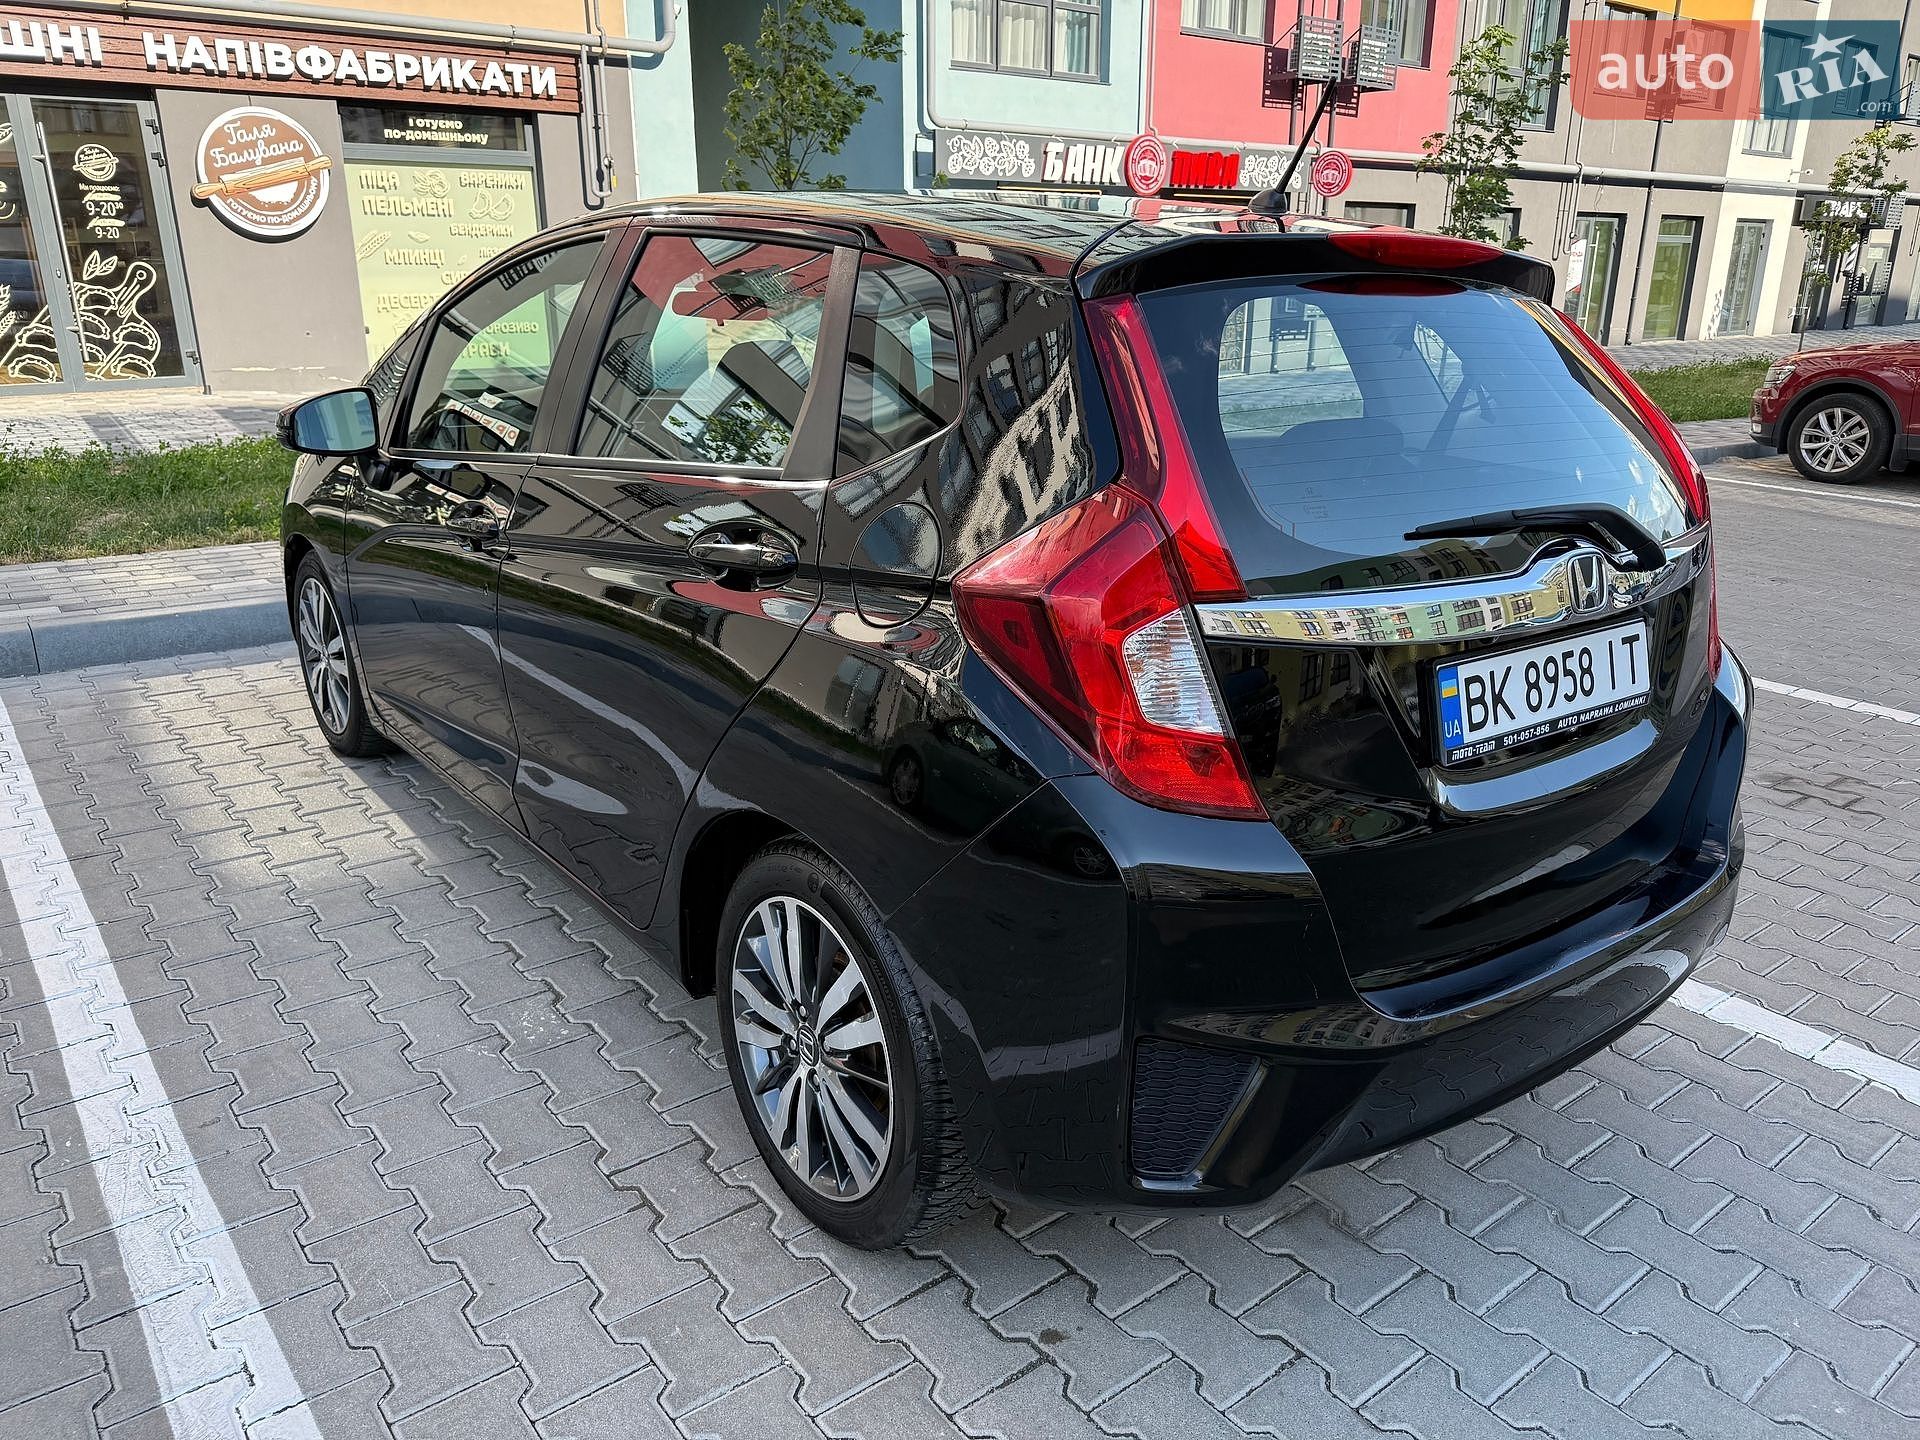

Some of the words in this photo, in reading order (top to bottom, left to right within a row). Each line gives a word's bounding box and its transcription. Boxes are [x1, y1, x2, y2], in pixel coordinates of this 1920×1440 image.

[142, 31, 558, 97] НАПІВФАБРИКАТИ
[223, 121, 276, 145] Галя
[209, 139, 304, 168] Балувана
[1043, 141, 1125, 184] БАНК
[359, 169, 400, 193] ПІЦА
[459, 171, 526, 190] ВАРЕНИКИ
[362, 195, 455, 218] ПЕЛЬМЕНІ
[95, 226, 120, 239] 9-20
[384, 248, 445, 269] МЛИНЦІ
[481, 321, 539, 335] ОРОЗИВО
[1464, 666, 1516, 732] BK
[1524, 647, 1595, 713] 8958
[1608, 633, 1640, 690] IT
[1444, 719, 1461, 738] UA
[1503, 723, 1550, 746] 501-057-856
[1557, 715, 1578, 729] AUTO
[1579, 703, 1613, 723] NAPRAWA
